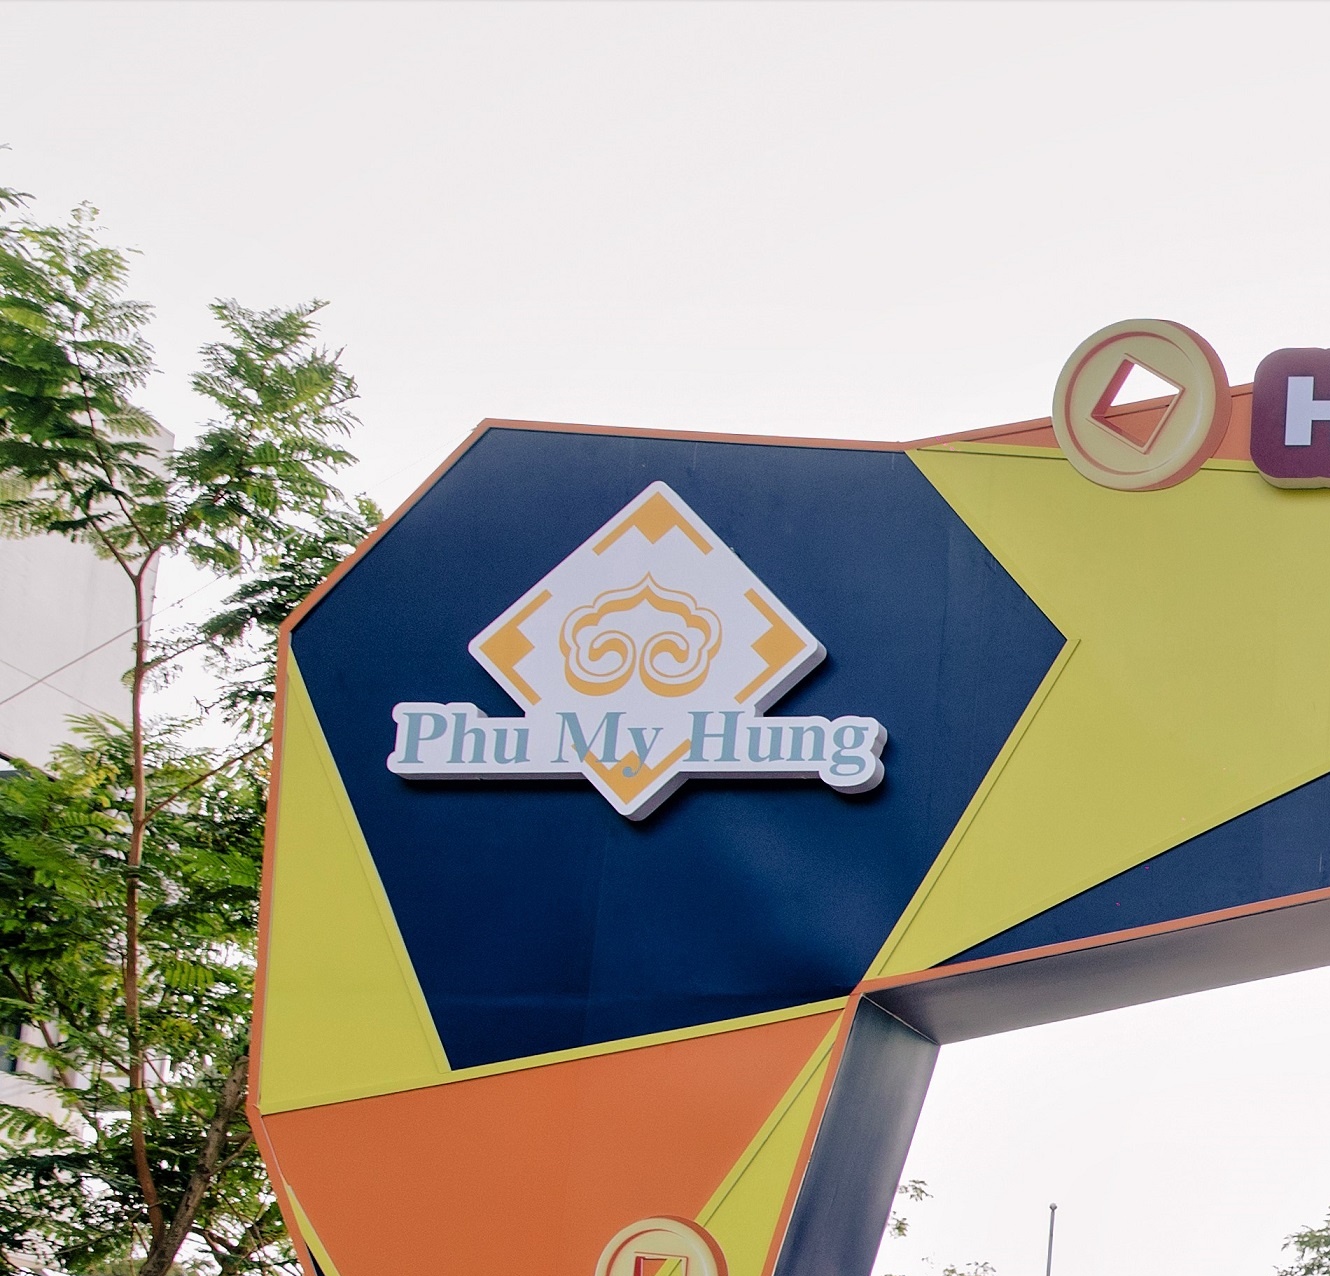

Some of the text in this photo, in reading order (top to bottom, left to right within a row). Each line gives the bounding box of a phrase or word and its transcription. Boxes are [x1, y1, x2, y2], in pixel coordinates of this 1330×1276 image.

[397, 710, 870, 778] Phu My Hung
